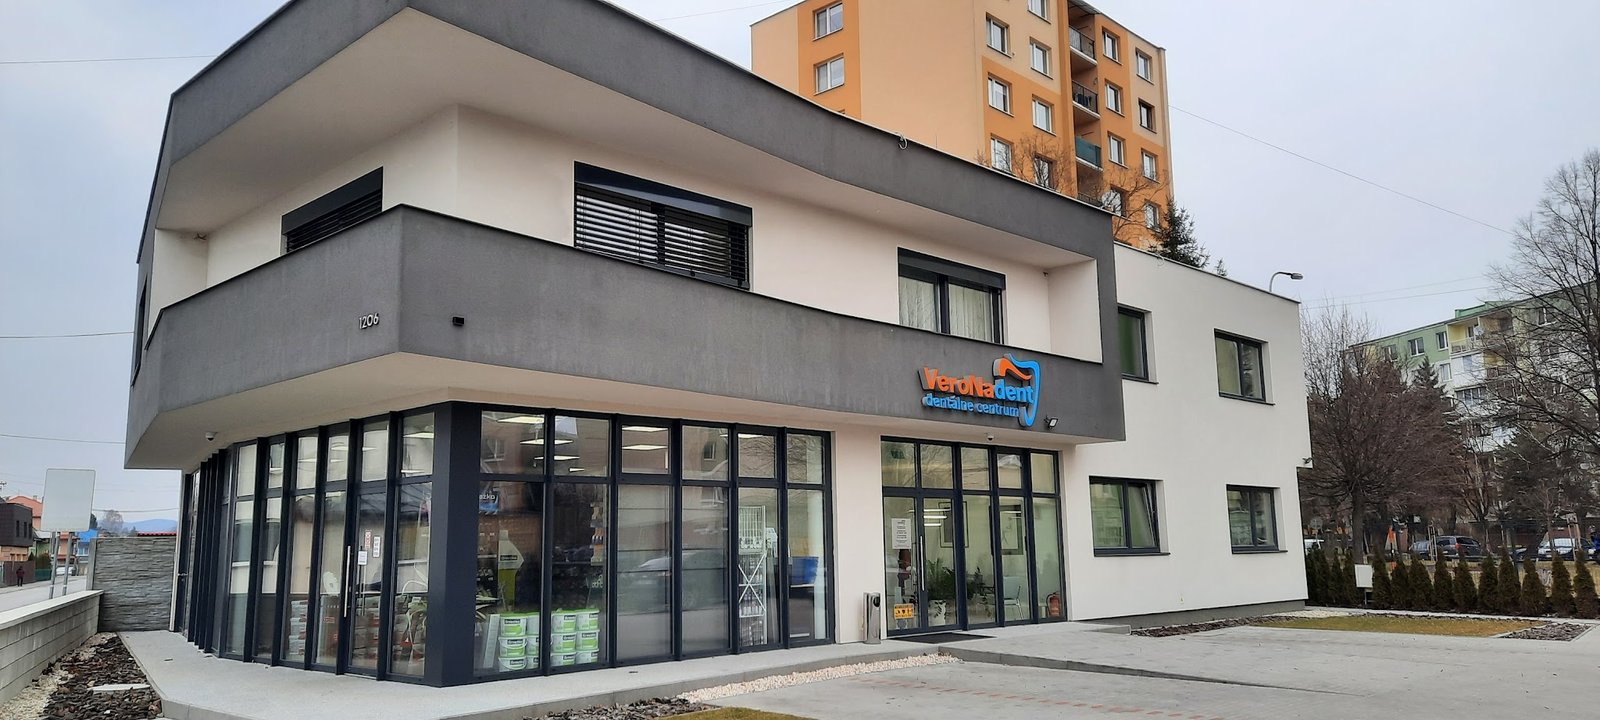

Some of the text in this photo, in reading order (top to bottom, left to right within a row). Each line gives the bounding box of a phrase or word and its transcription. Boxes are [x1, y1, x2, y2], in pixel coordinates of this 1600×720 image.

[359, 312, 379, 329] 1206
[922, 366, 1034, 404] VeroNadent
[924, 393, 1019, 417] dentálne centrum
